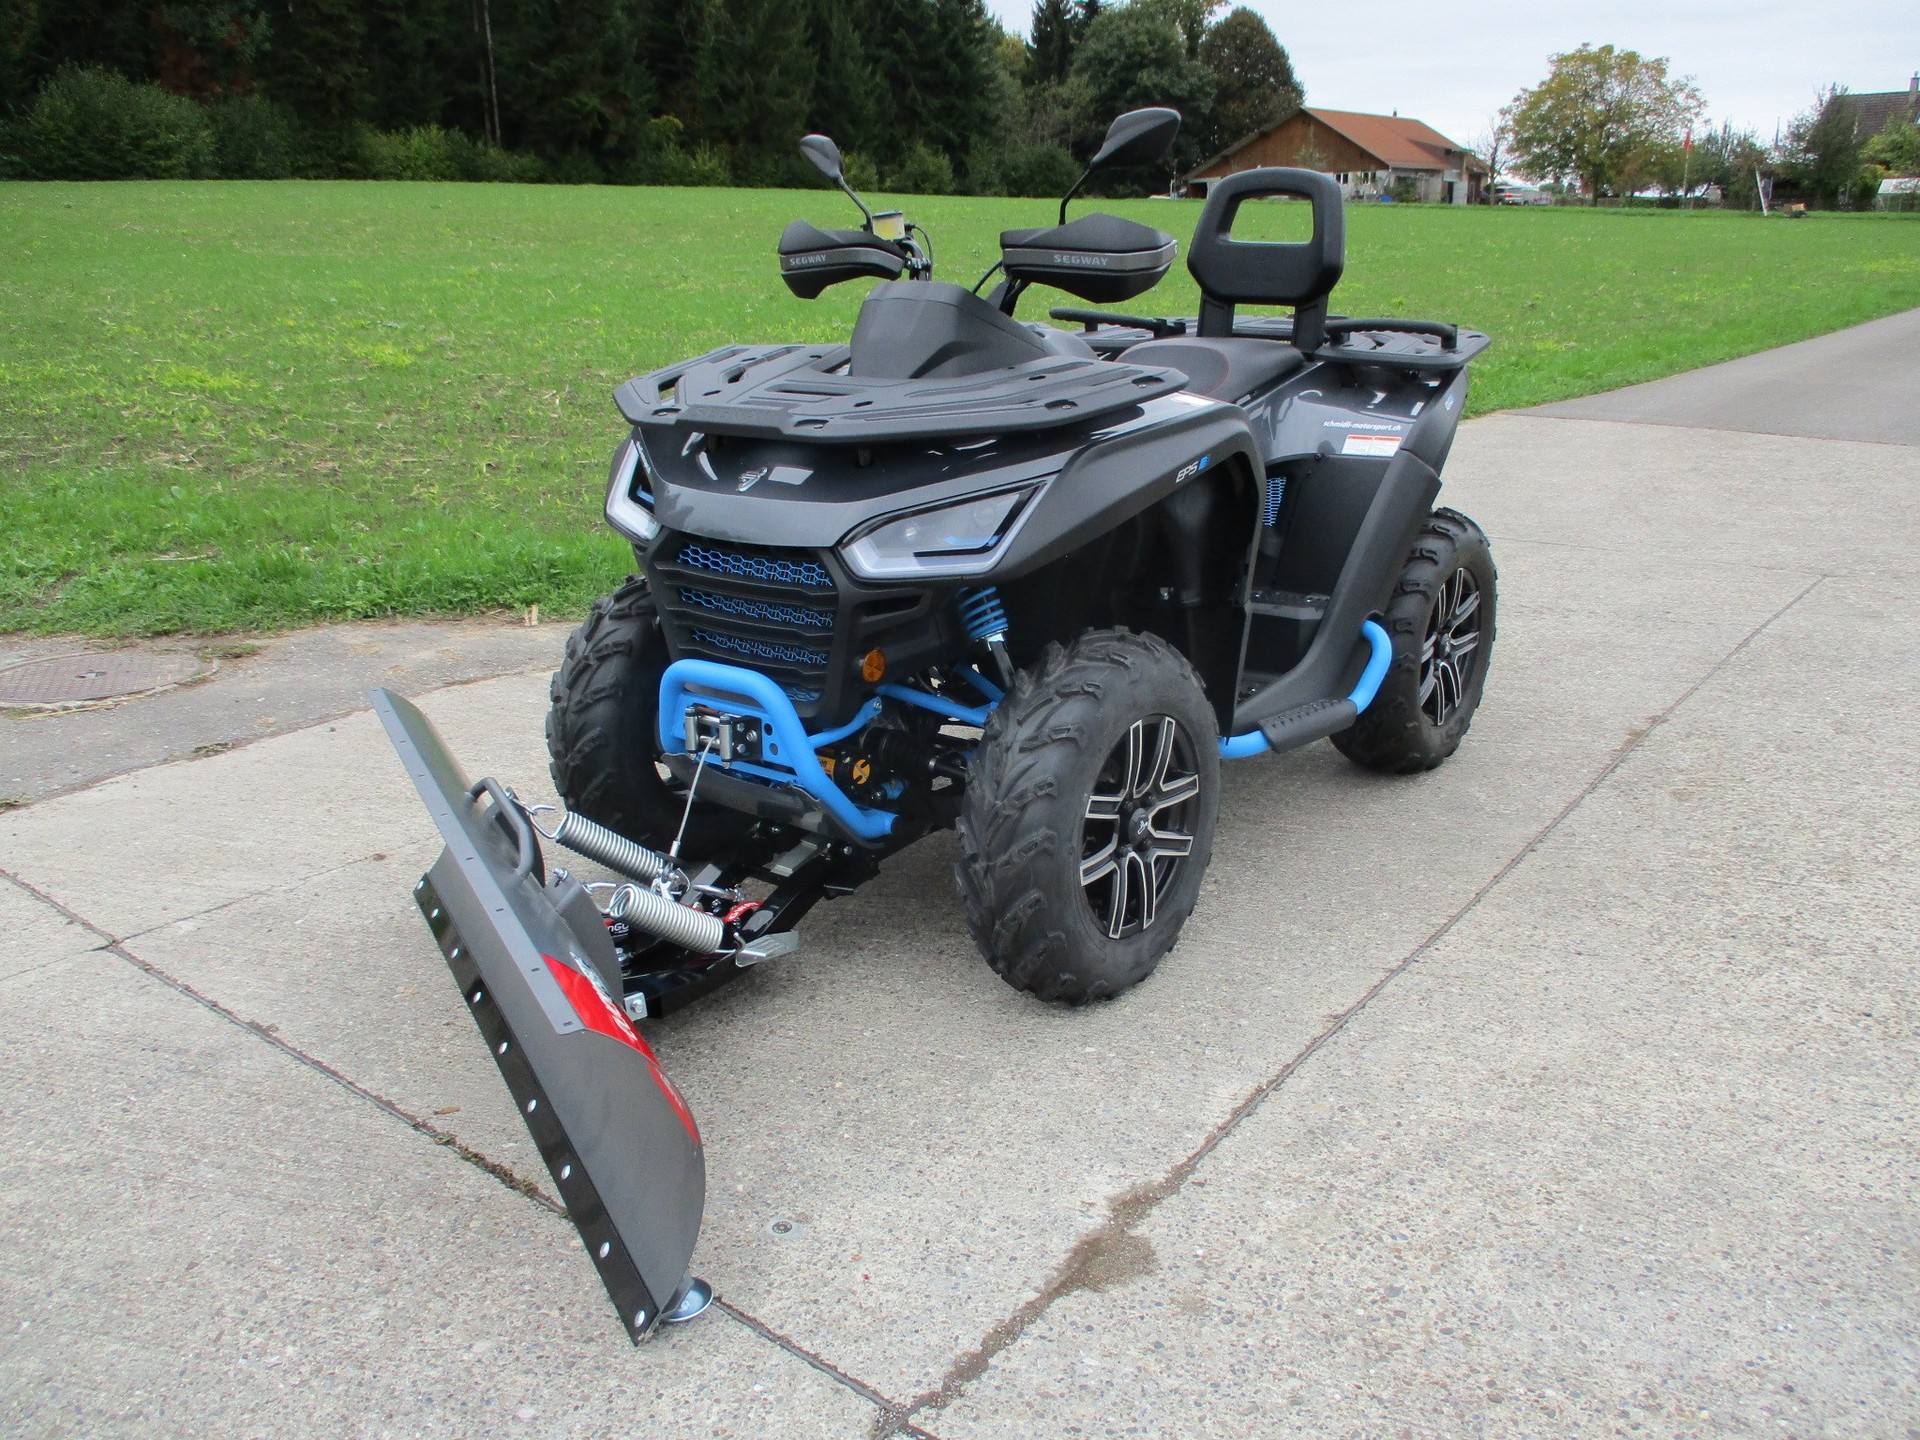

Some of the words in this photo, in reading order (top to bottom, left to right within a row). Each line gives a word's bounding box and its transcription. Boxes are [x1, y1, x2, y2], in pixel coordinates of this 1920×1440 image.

[790, 254, 826, 266] SEGWAY
[1053, 253, 1109, 267] SEGWAY
[1175, 460, 1199, 483] EPS
